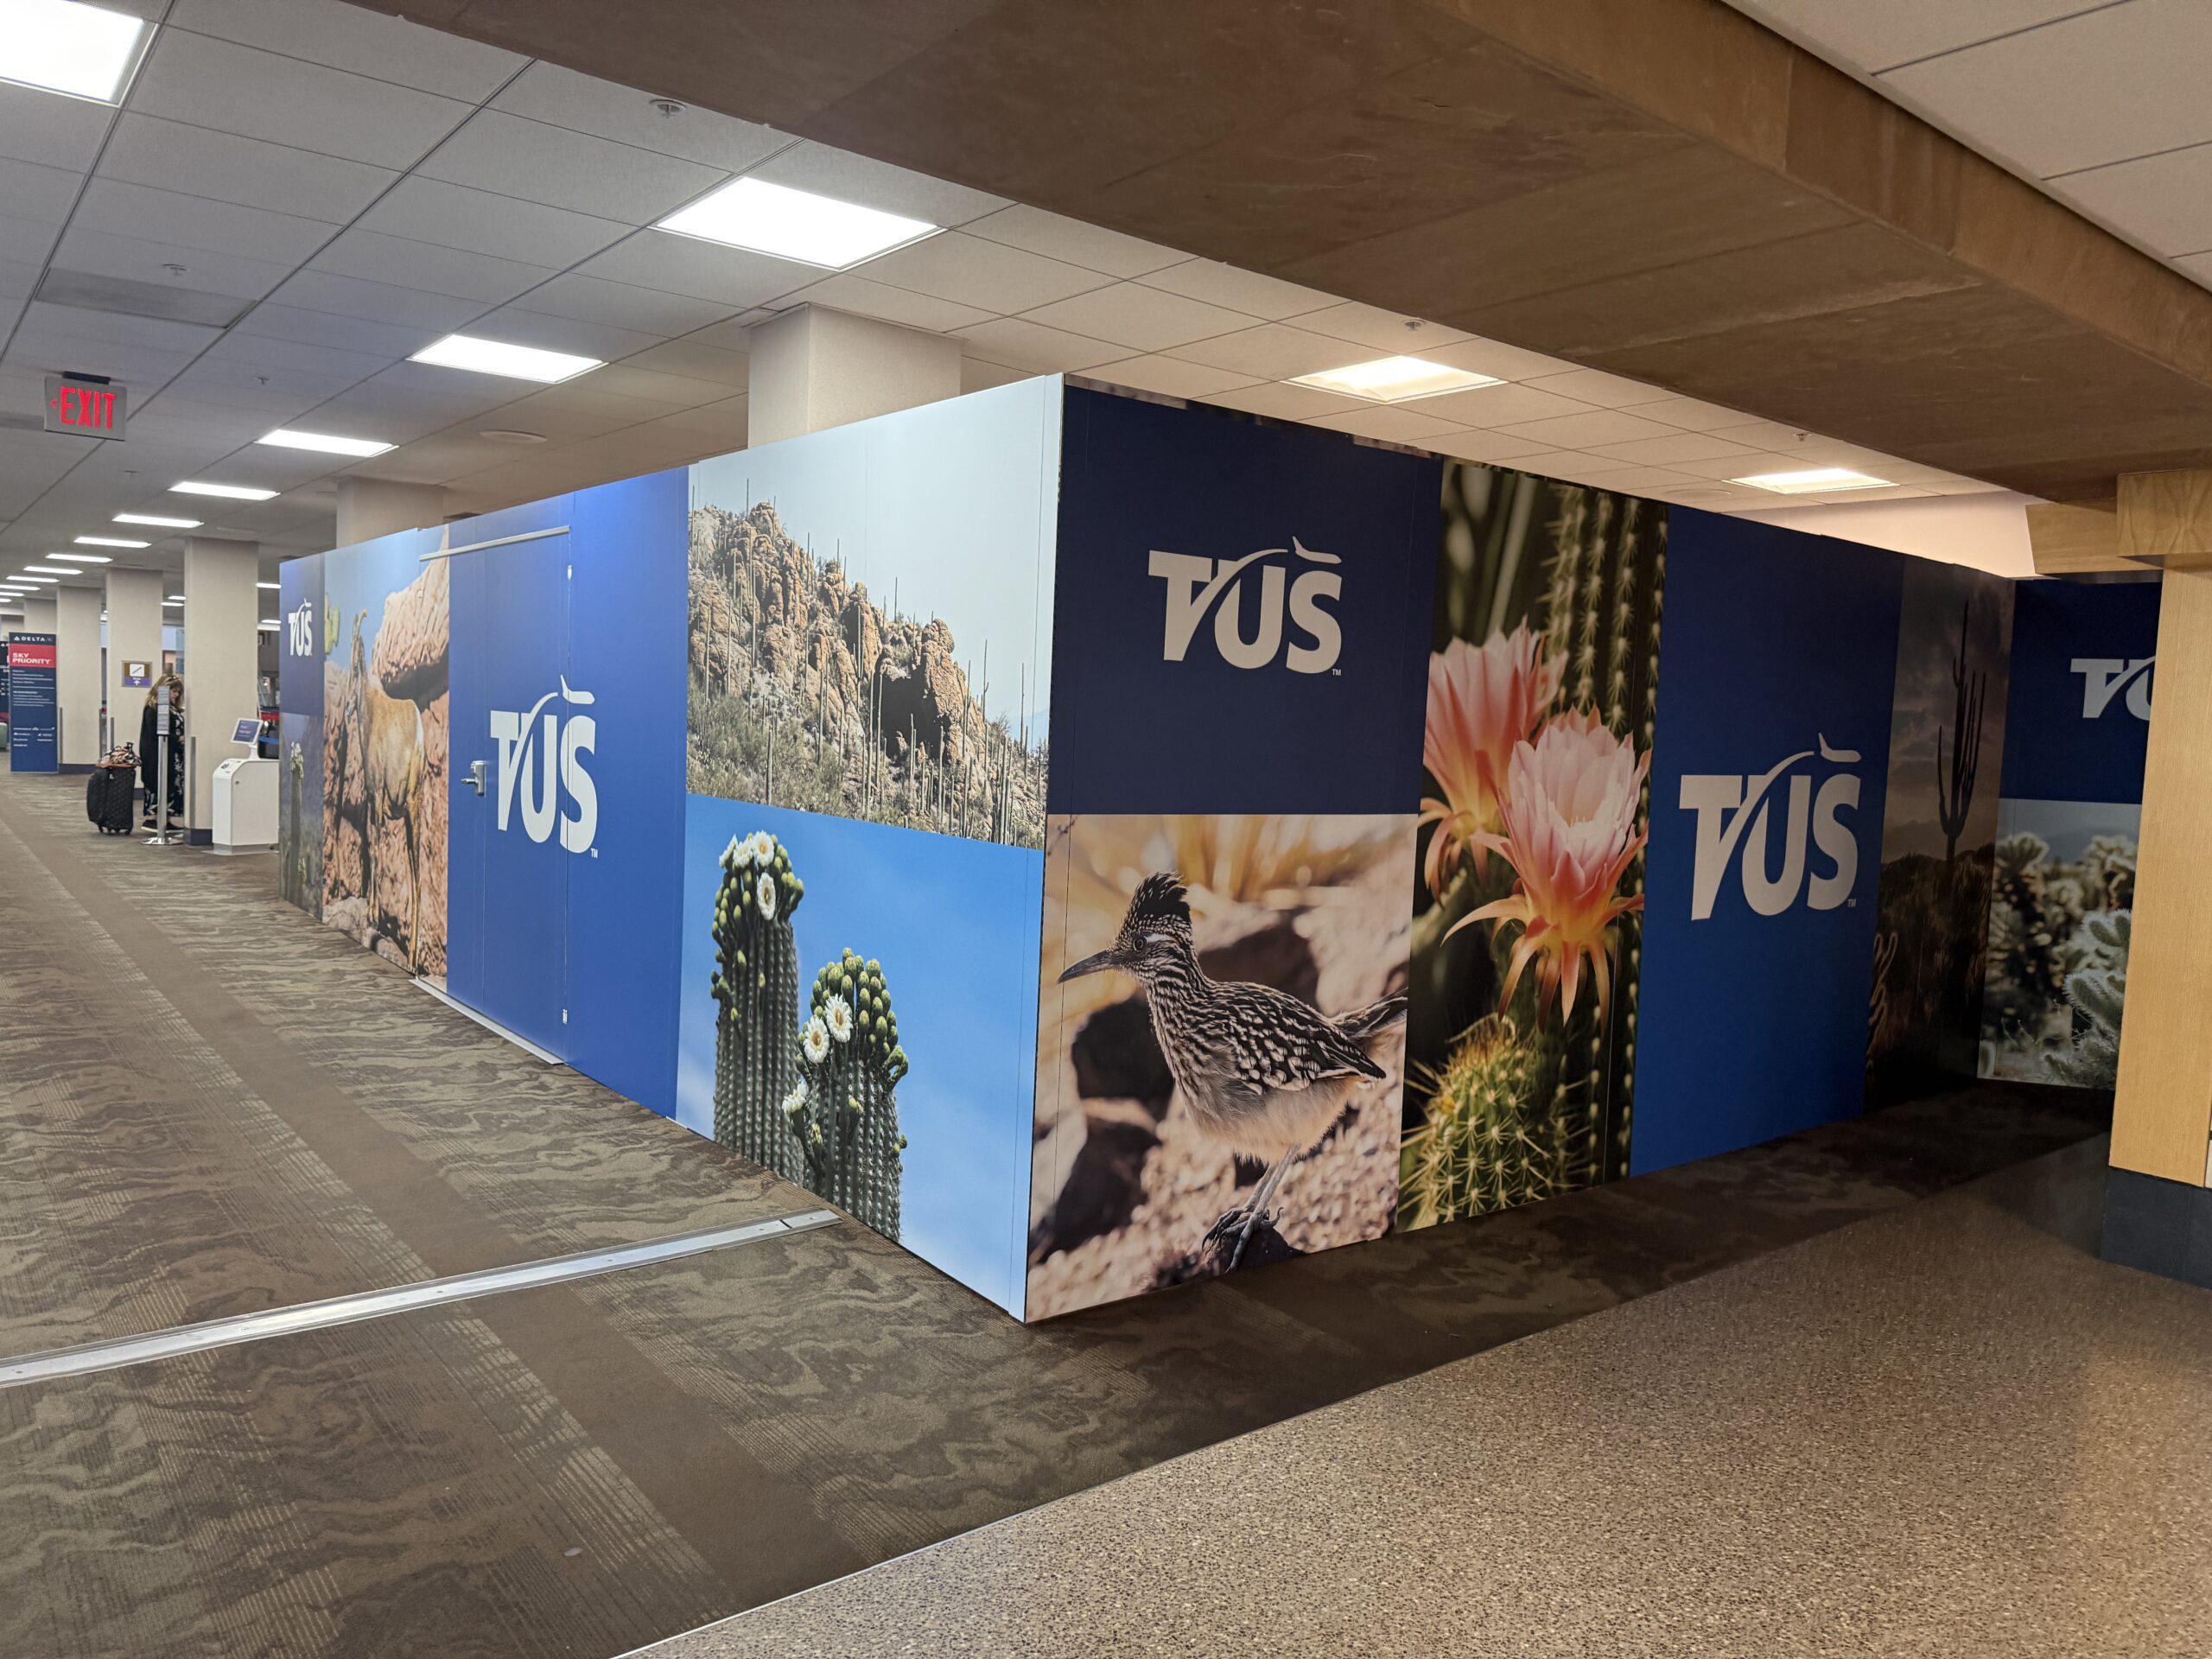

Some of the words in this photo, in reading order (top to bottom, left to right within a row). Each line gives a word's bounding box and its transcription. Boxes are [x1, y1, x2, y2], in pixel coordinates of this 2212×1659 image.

[60, 386, 117, 429] EXIT
[288, 603, 313, 657] TUS
[1148, 548, 1343, 674] TUS
[490, 691, 598, 854] TUS
[1679, 750, 1862, 921] TUS
